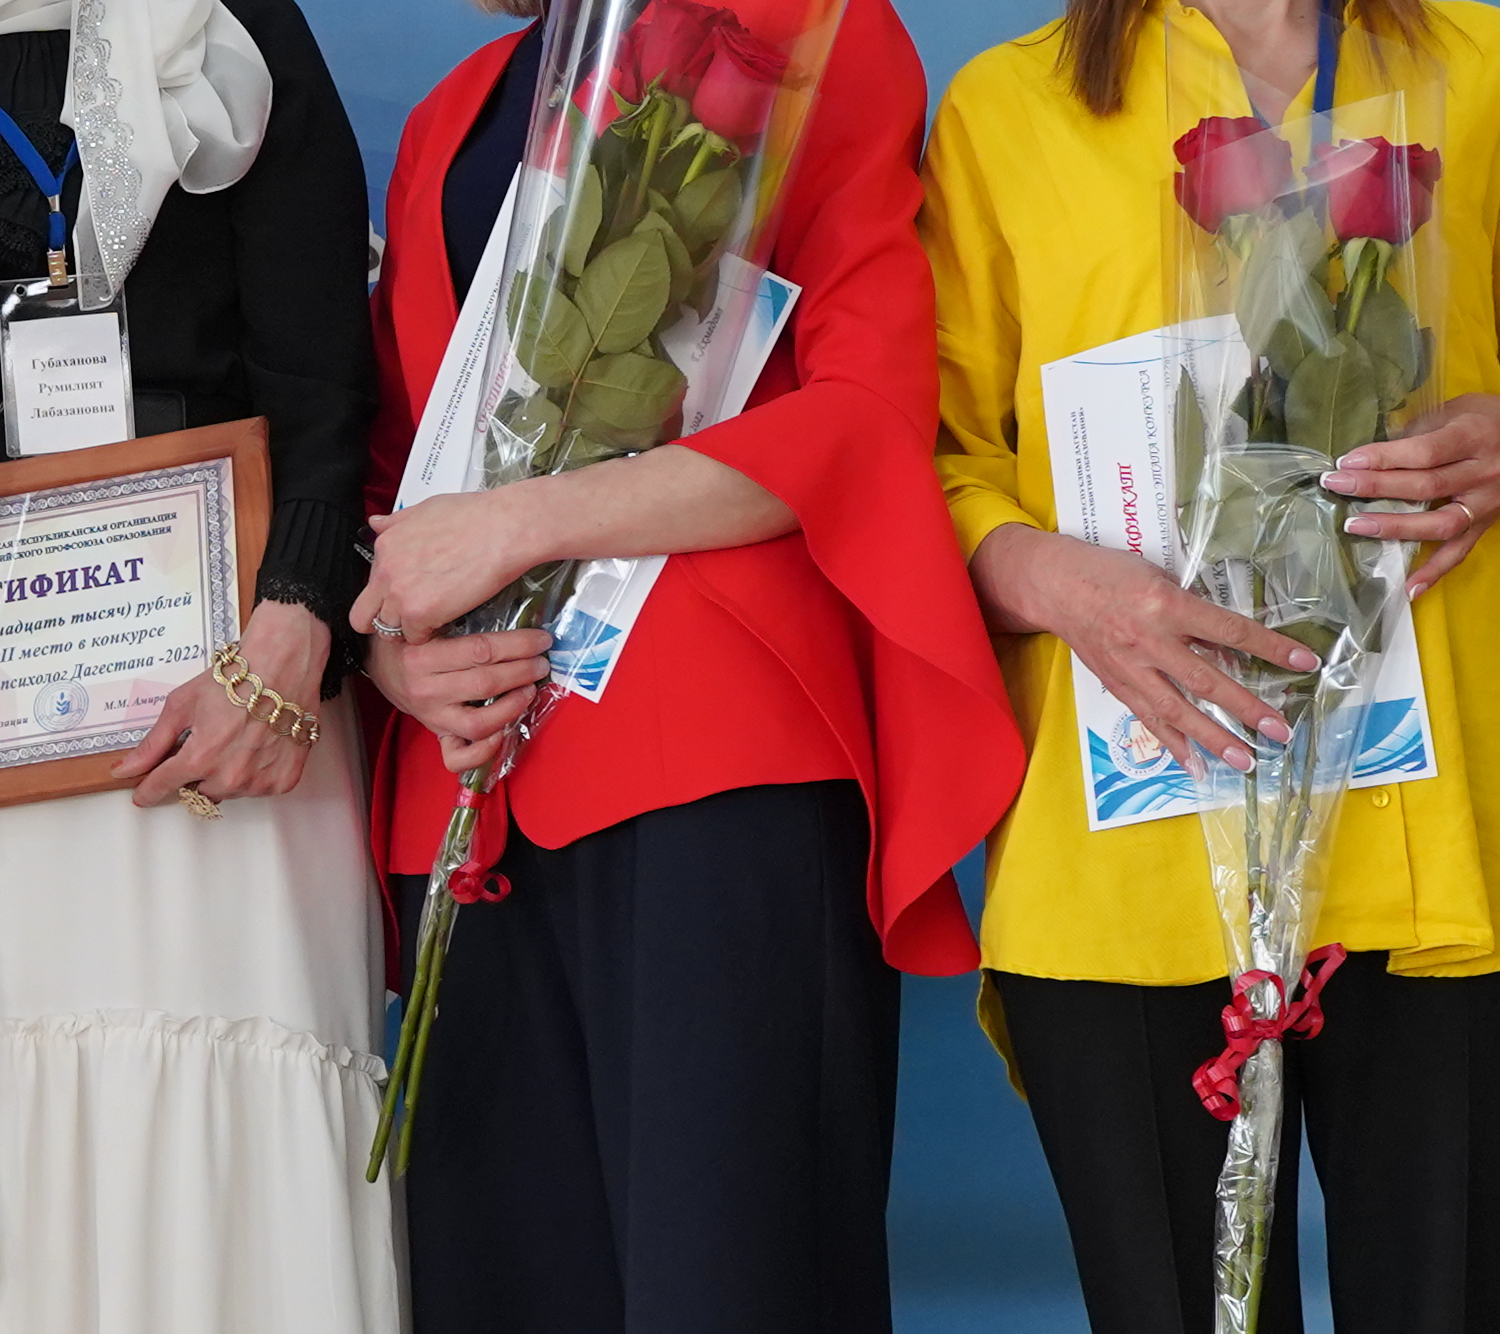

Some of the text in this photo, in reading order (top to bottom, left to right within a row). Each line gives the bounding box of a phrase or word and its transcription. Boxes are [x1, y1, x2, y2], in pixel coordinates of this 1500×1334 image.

[31, 355, 107, 372] Губаханова
[30, 404, 115, 419] Лабазановна
[1138, 369, 1175, 575] ОНАЛЬНОГО ЭТАПА КОНКУРСА
[1116, 462, 1143, 557] ИФИКАТ
[16, 524, 108, 546] ЕСПУБЛИКАНСКАЯ
[110, 512, 177, 530] ОРГАНИЗАЦИЯ
[45, 538, 104, 554] ПРОФСОЮЗА
[106, 526, 172, 544] ОБРАЗОВАНИЯ
[71, 602, 131, 625] тысяч)
[136, 591, 192, 617] рублей
[0, 647, 16, 664] II
[19, 641, 73, 659] место
[78, 639, 87, 650] в
[91, 625, 166, 648] конкурсе
[70, 655, 154, 681] Дагестана
[158, 644, 208, 664] -2022»
[104, 691, 169, 711] М.М. Амиро
